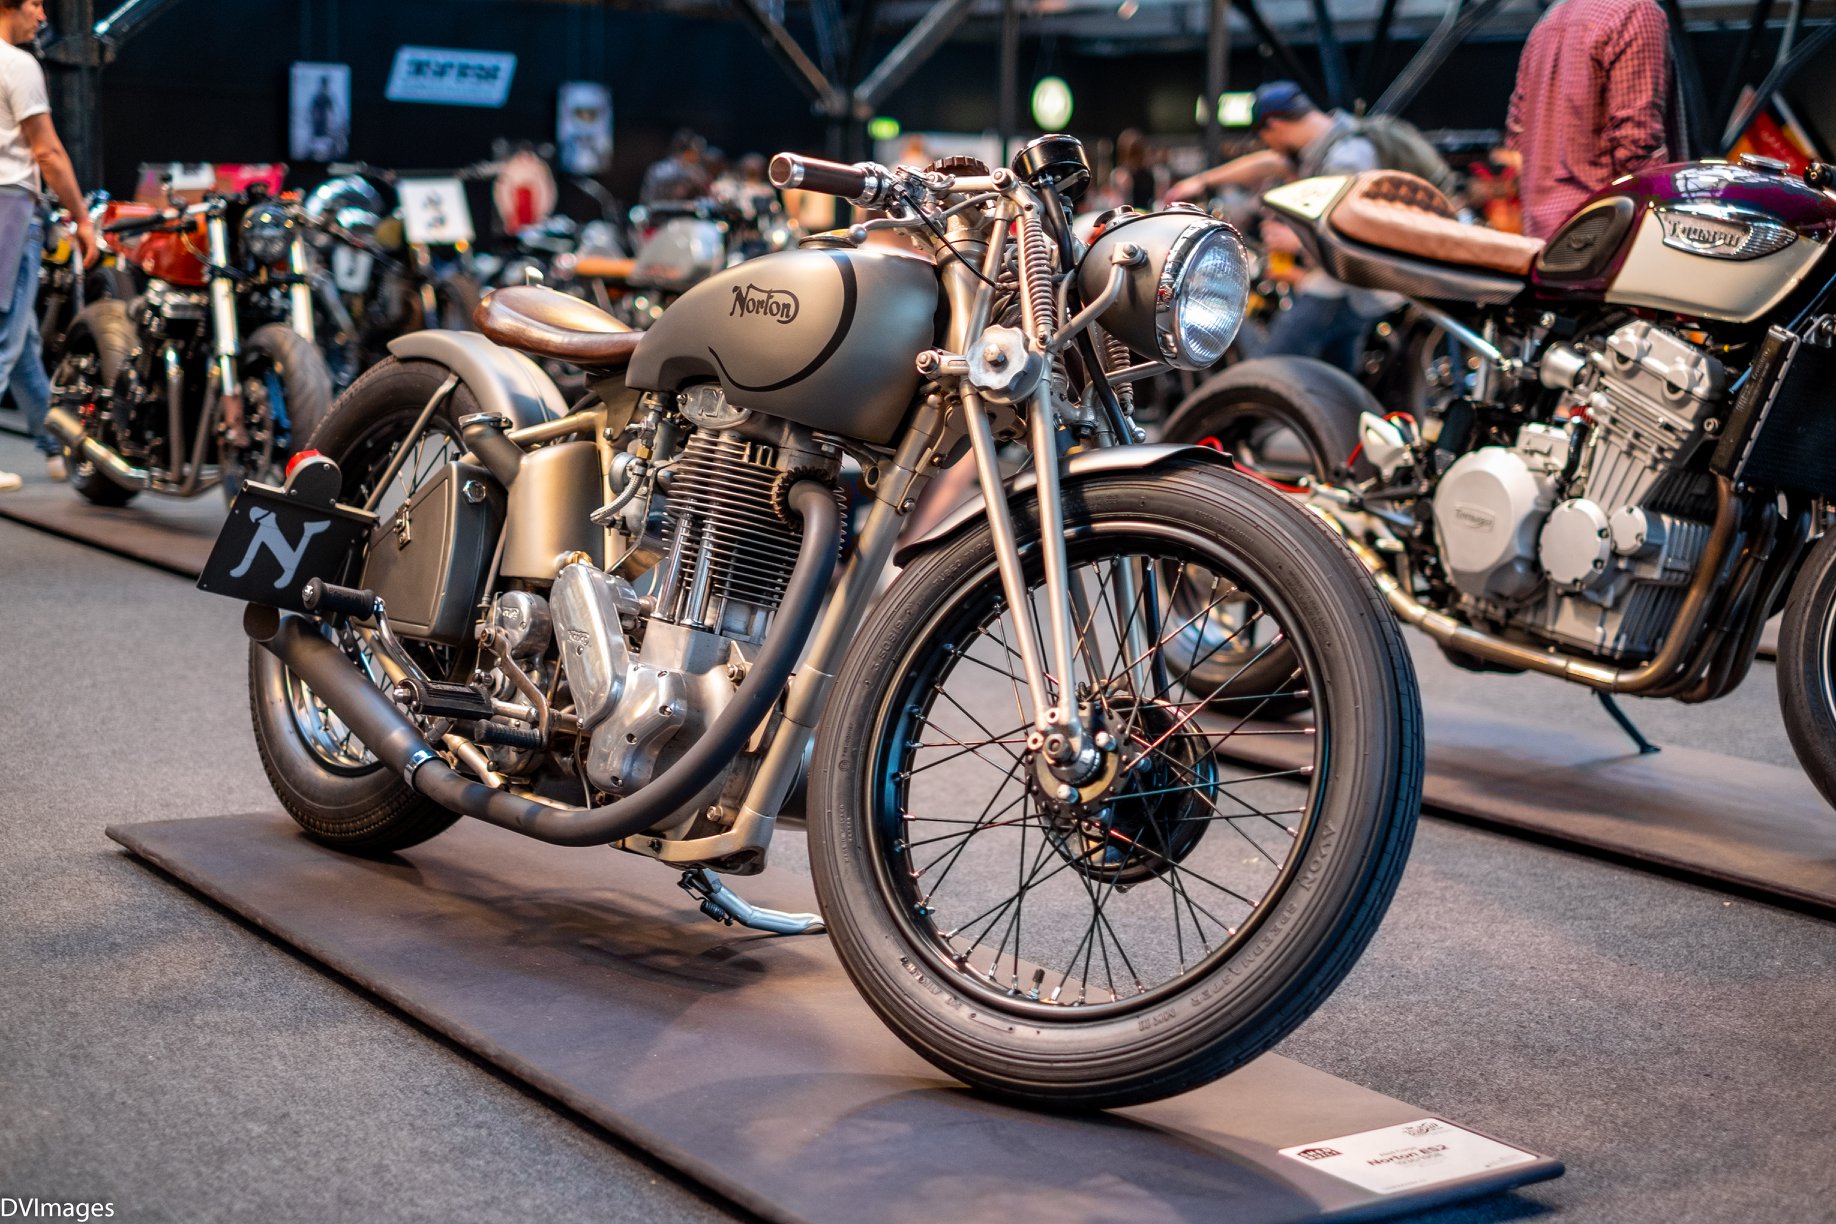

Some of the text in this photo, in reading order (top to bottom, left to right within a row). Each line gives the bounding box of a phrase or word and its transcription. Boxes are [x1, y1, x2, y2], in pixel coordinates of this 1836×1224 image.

[729, 283, 799, 324] Norton
[229, 506, 331, 589] N
[1299, 821, 1337, 892] AVON
[1367, 1152, 1419, 1166] Norton
